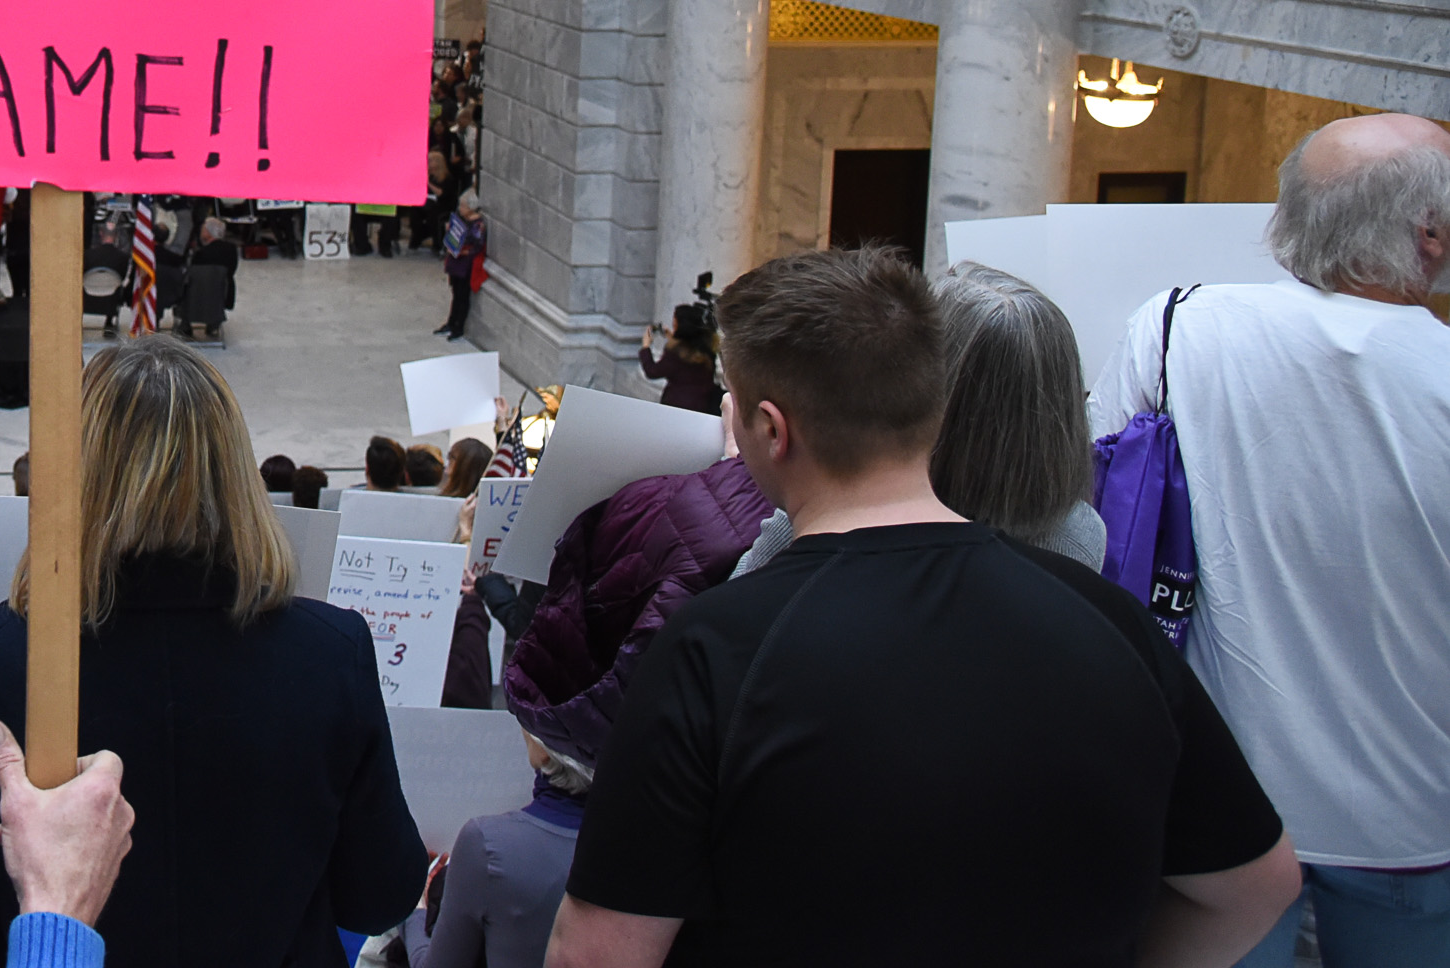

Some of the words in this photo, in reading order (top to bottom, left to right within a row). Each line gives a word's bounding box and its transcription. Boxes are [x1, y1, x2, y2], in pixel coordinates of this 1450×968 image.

[339, 550, 374, 568] Not
[385, 555, 408, 582] Try
[388, 643, 407, 665] 3
